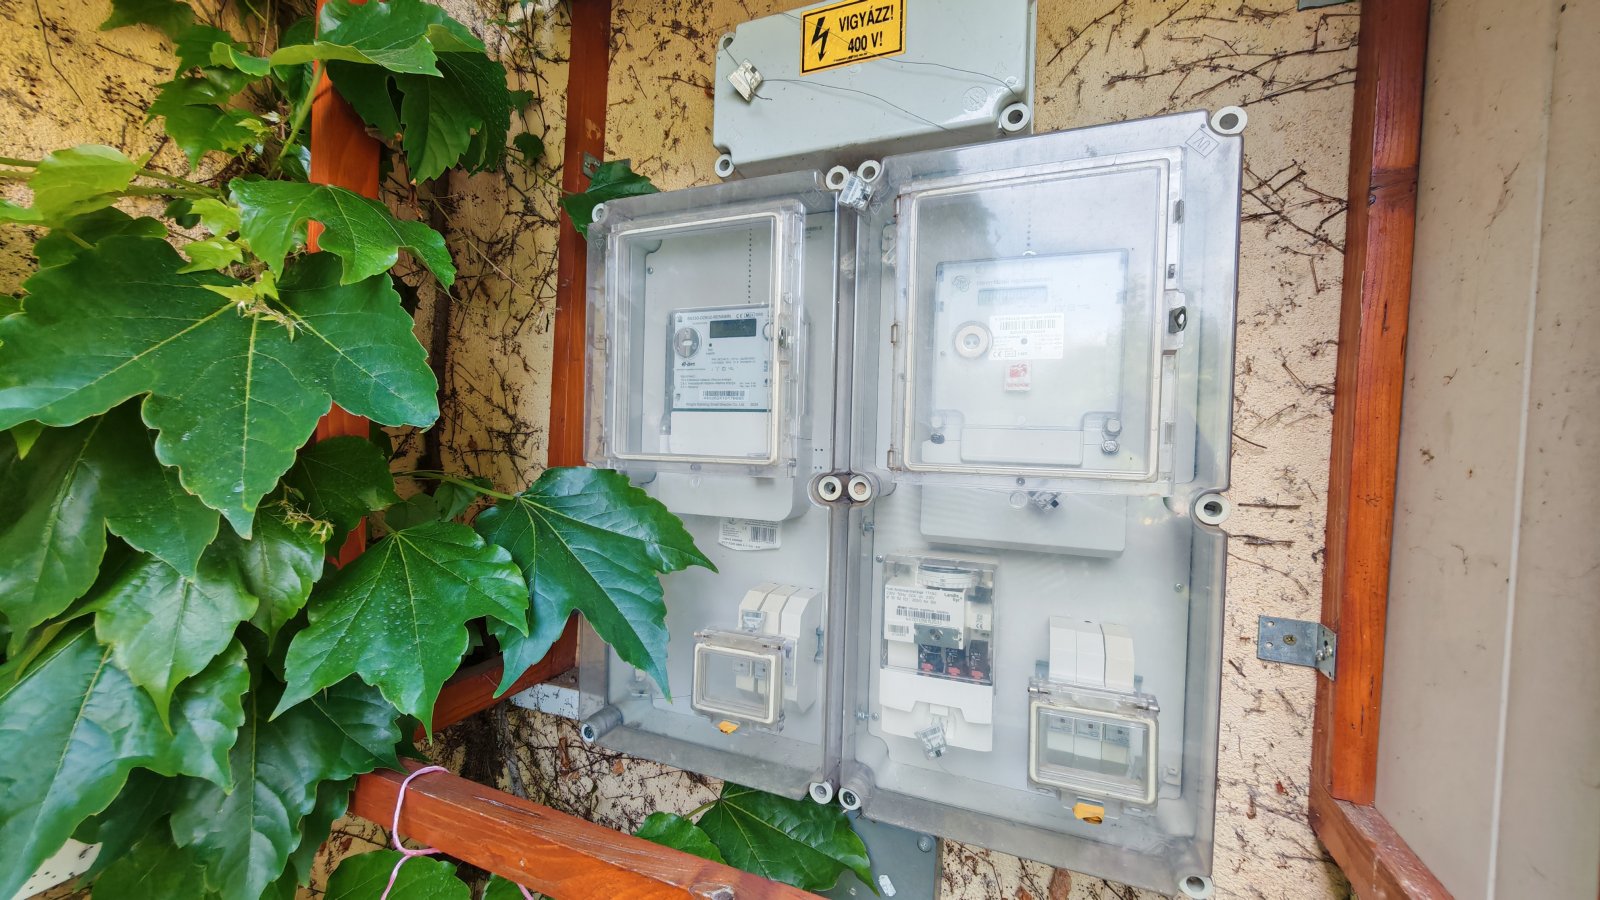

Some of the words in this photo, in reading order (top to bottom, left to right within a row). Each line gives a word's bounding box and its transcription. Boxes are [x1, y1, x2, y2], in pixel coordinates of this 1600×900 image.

[839, 5, 894, 32] VIGYÁZZ!
[848, 35, 868, 53] 400
[871, 31, 883, 48] V!
